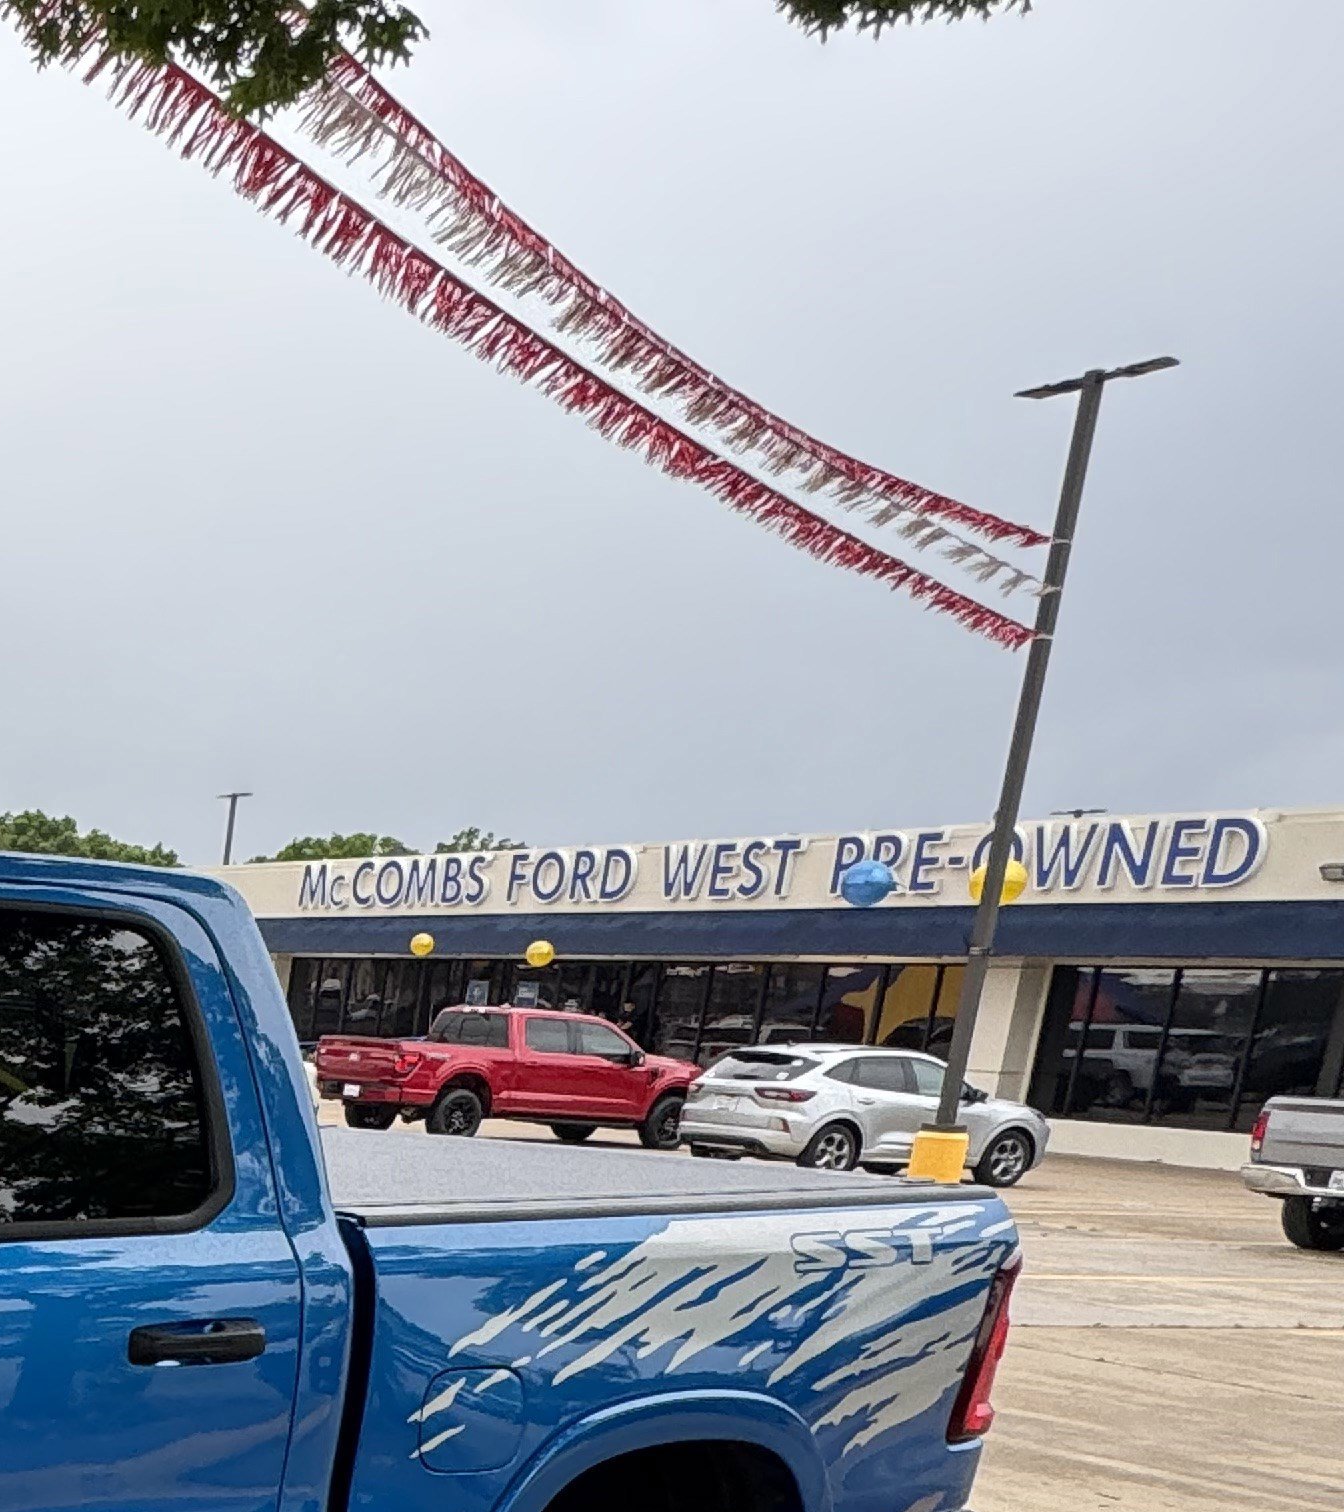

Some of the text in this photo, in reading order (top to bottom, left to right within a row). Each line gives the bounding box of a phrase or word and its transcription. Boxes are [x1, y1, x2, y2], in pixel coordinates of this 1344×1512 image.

[298, 855, 489, 908] McCOMBS
[506, 849, 635, 904] FORD
[663, 840, 803, 898] WEST
[790, 1225, 944, 1273] SST
